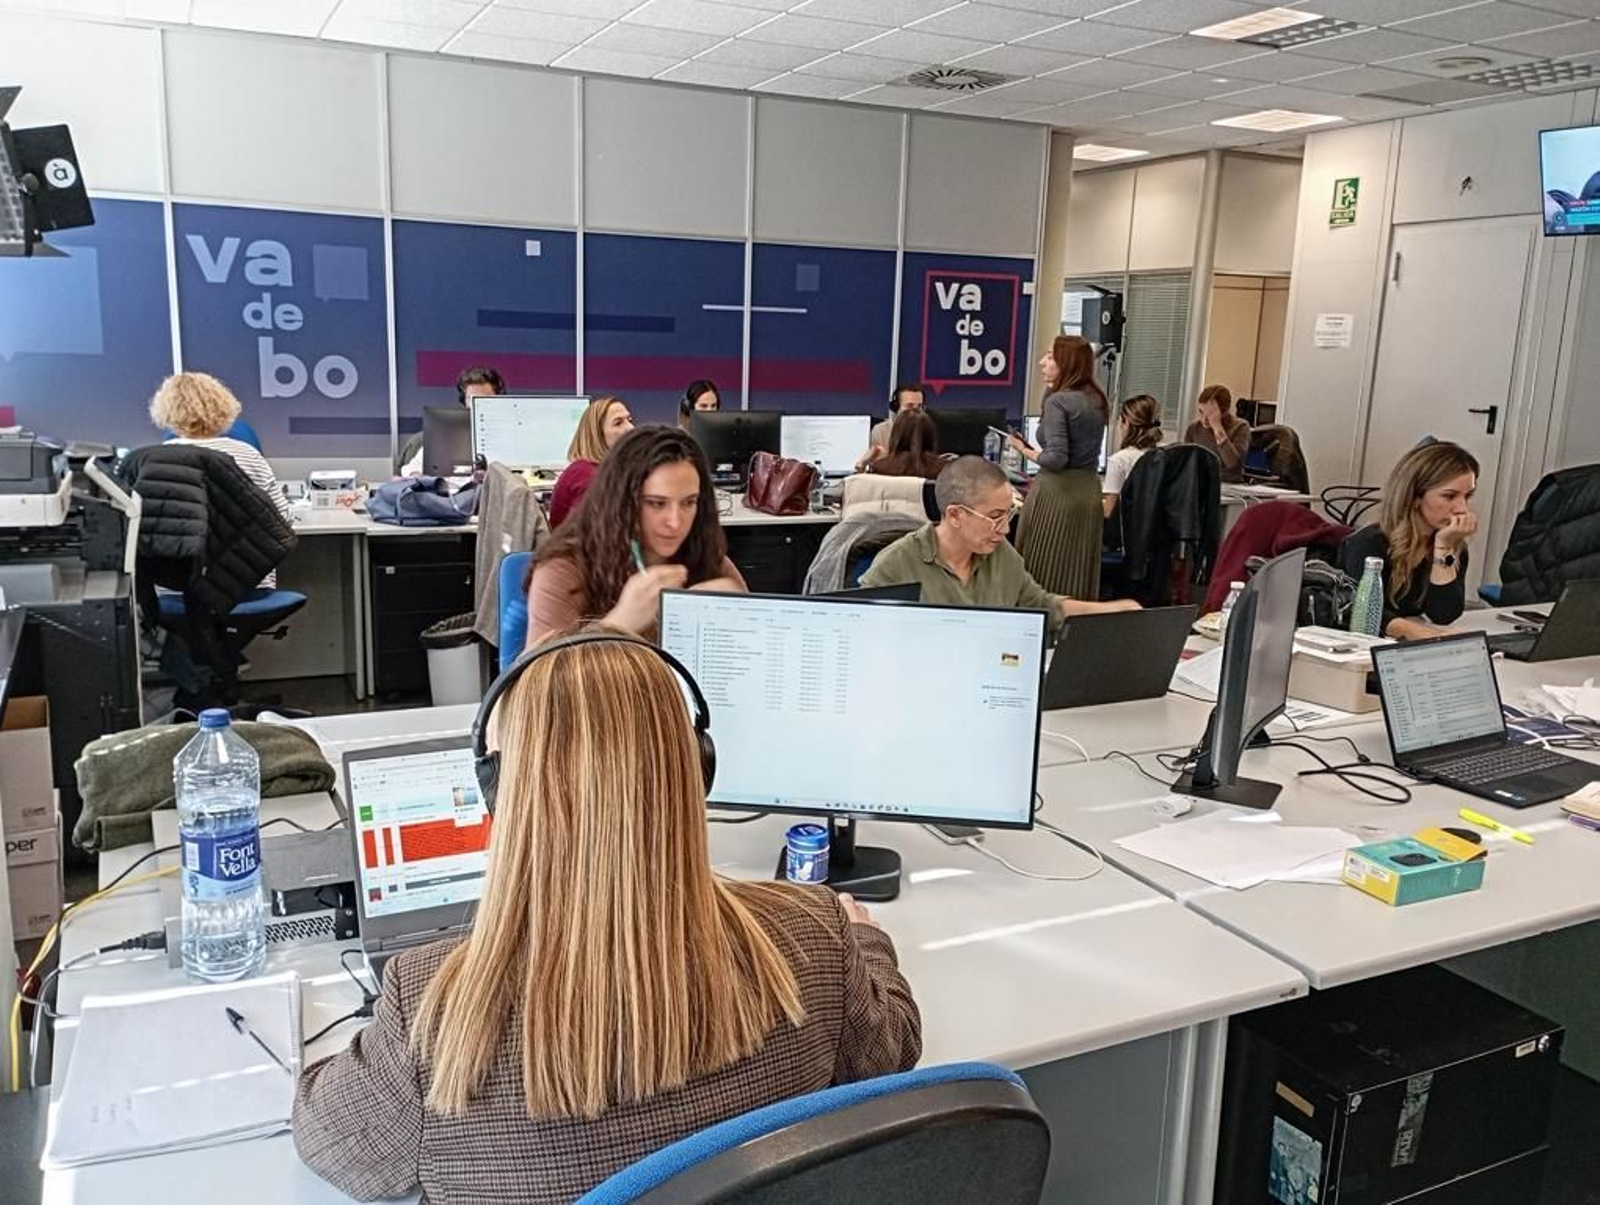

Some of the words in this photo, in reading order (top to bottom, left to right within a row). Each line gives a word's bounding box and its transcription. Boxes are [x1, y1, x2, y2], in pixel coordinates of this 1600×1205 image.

[52, 162, 68, 181] à
[186, 233, 293, 287] va
[933, 281, 983, 311] va
[243, 292, 304, 331] de
[955, 313, 985, 336] de
[257, 336, 358, 399] bo
[959, 339, 1007, 376] bo
[218, 857, 256, 878] Vella
[219, 842, 255, 864] Font
